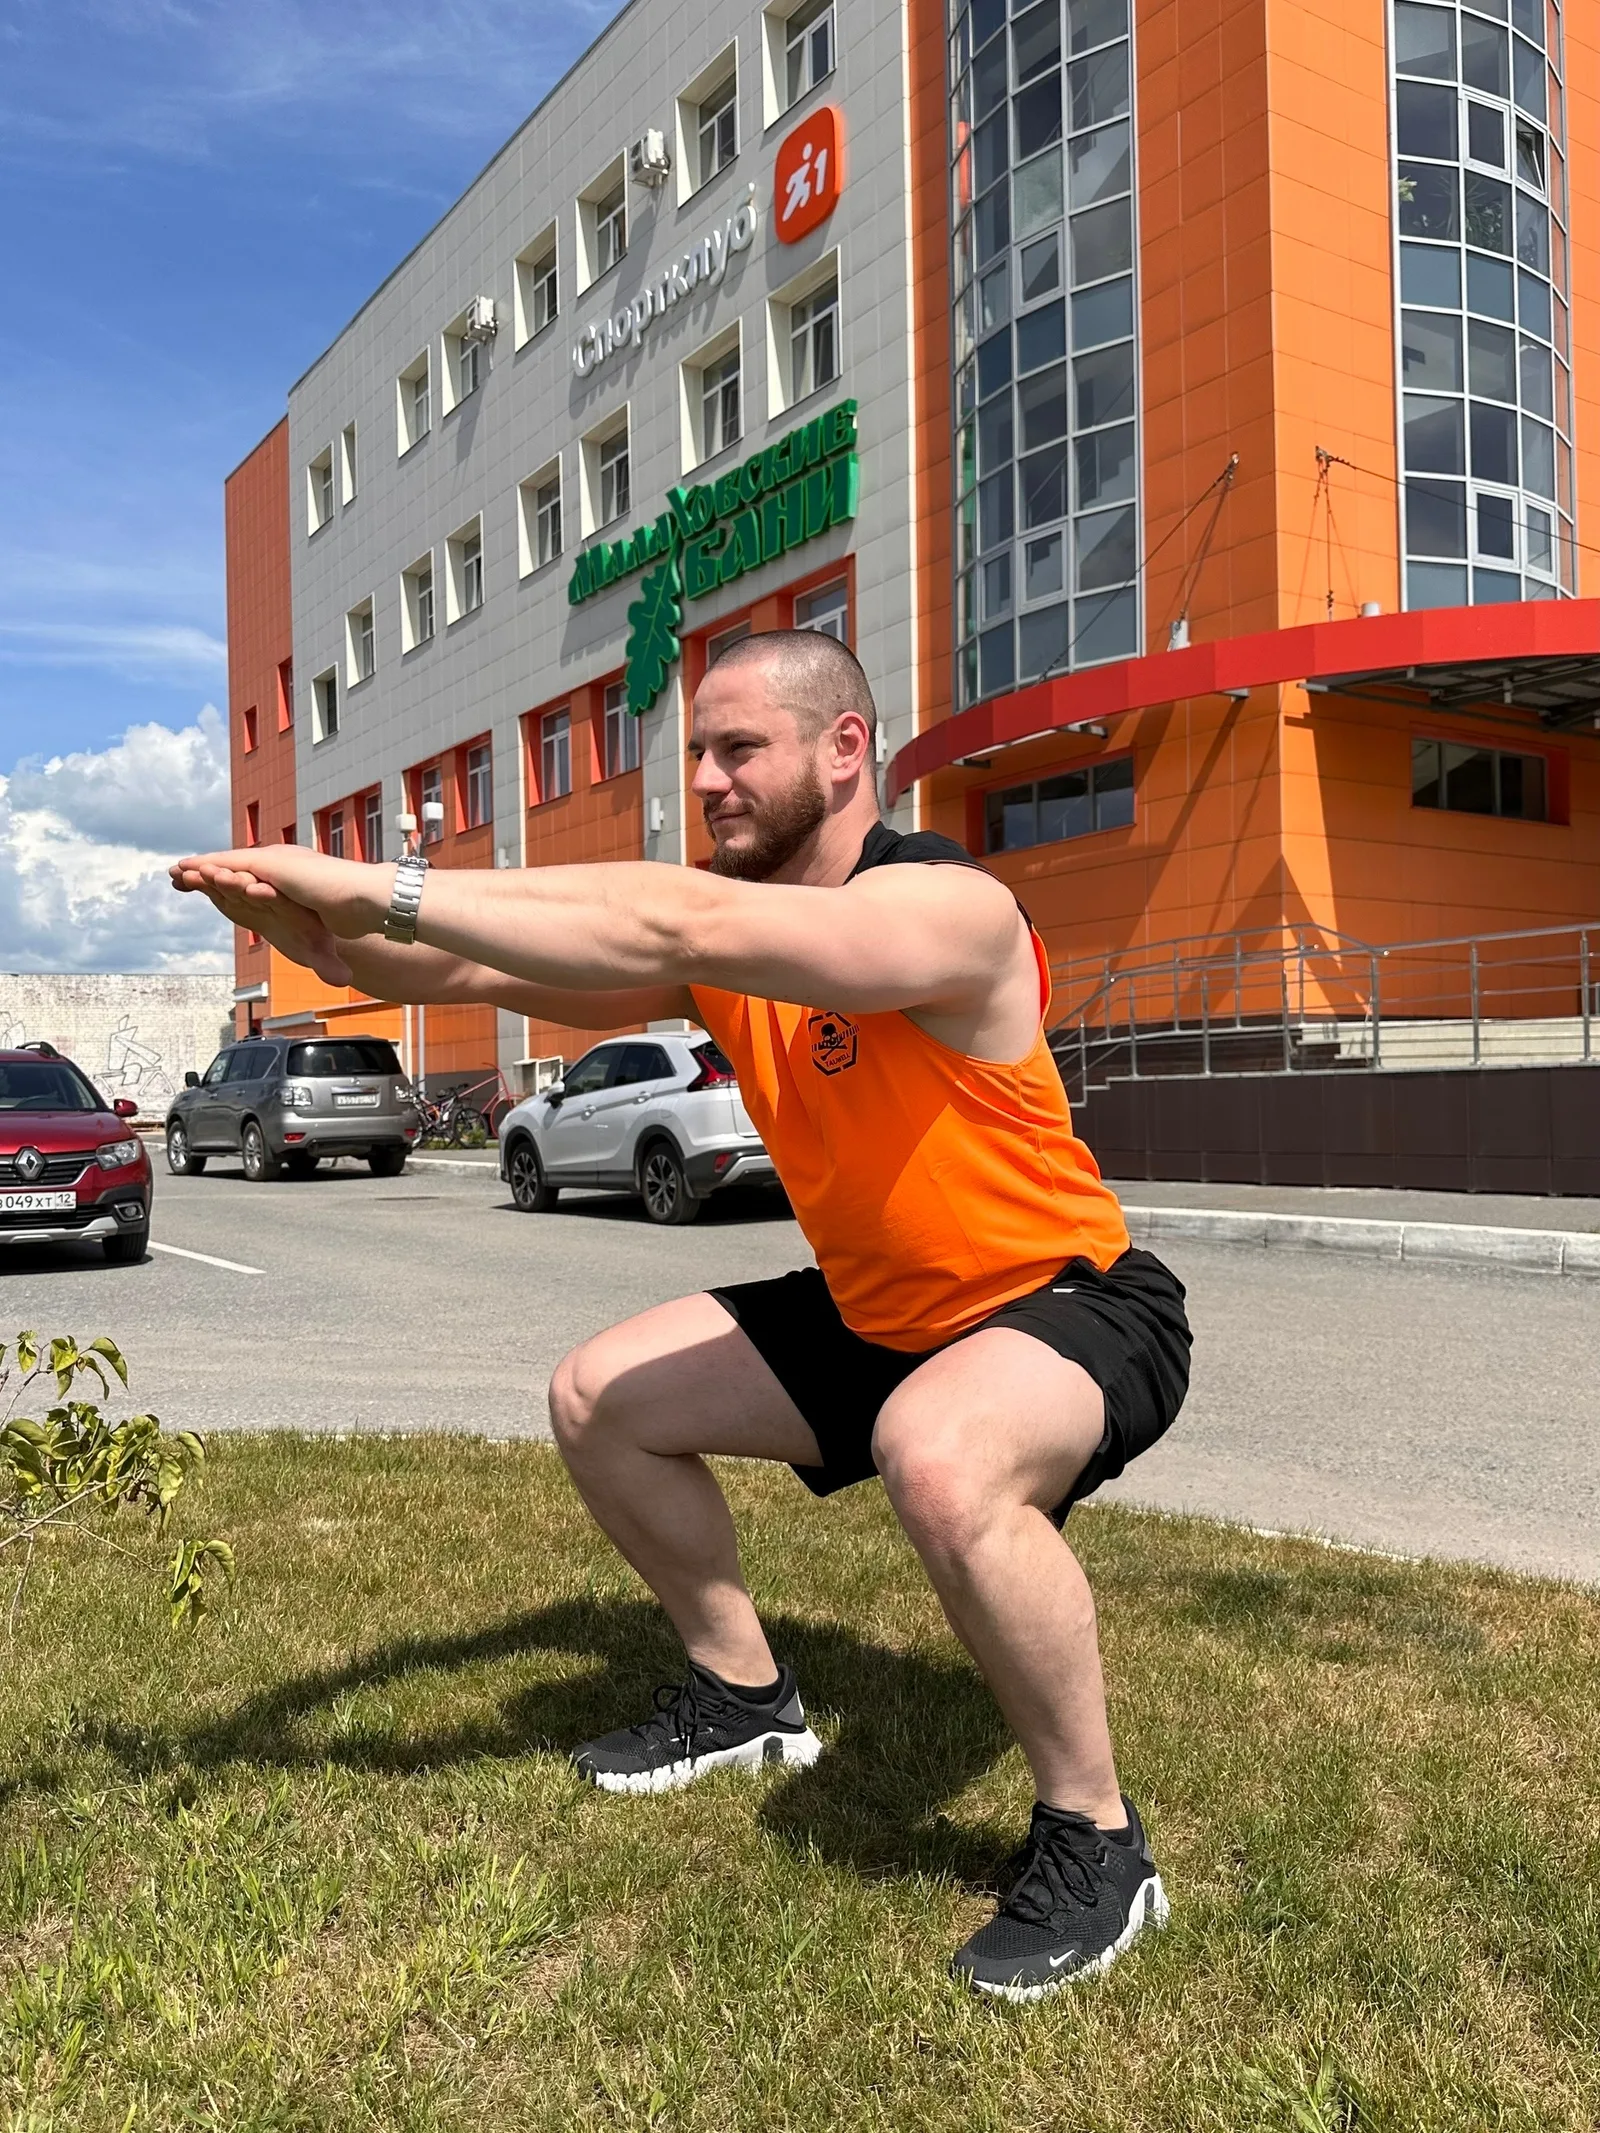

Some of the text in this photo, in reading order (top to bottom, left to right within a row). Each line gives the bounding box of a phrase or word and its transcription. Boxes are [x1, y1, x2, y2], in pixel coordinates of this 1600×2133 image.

[572, 182, 757, 378] Спортклуб
[684, 452, 859, 601] БАНИ
[57, 1193, 71, 1204] 12
